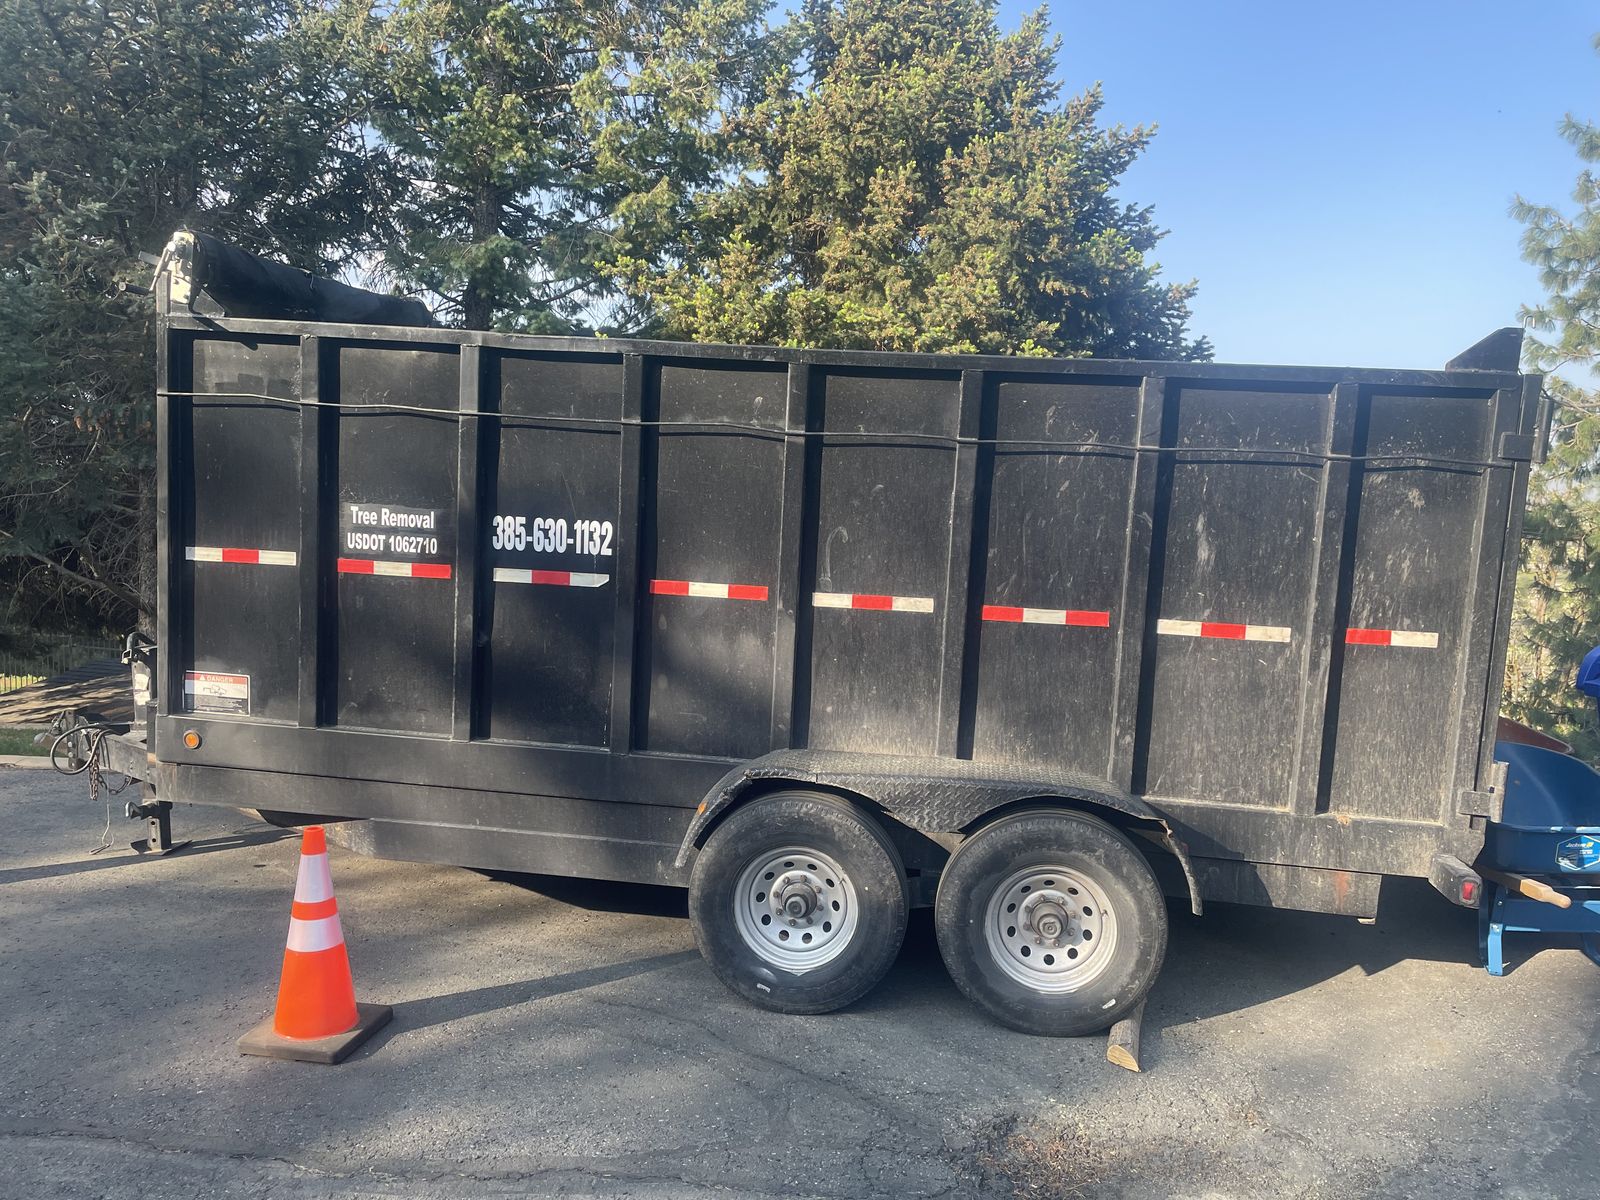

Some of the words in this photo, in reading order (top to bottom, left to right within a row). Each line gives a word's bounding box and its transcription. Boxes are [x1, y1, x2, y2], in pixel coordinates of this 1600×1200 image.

[350, 505, 378, 525] Tree
[381, 507, 435, 529] Removal
[347, 532, 386, 551] USDOT
[388, 535, 438, 555] 1062710
[492, 516, 613, 556] 385-630-1132
[206, 675, 234, 683] DANGER
